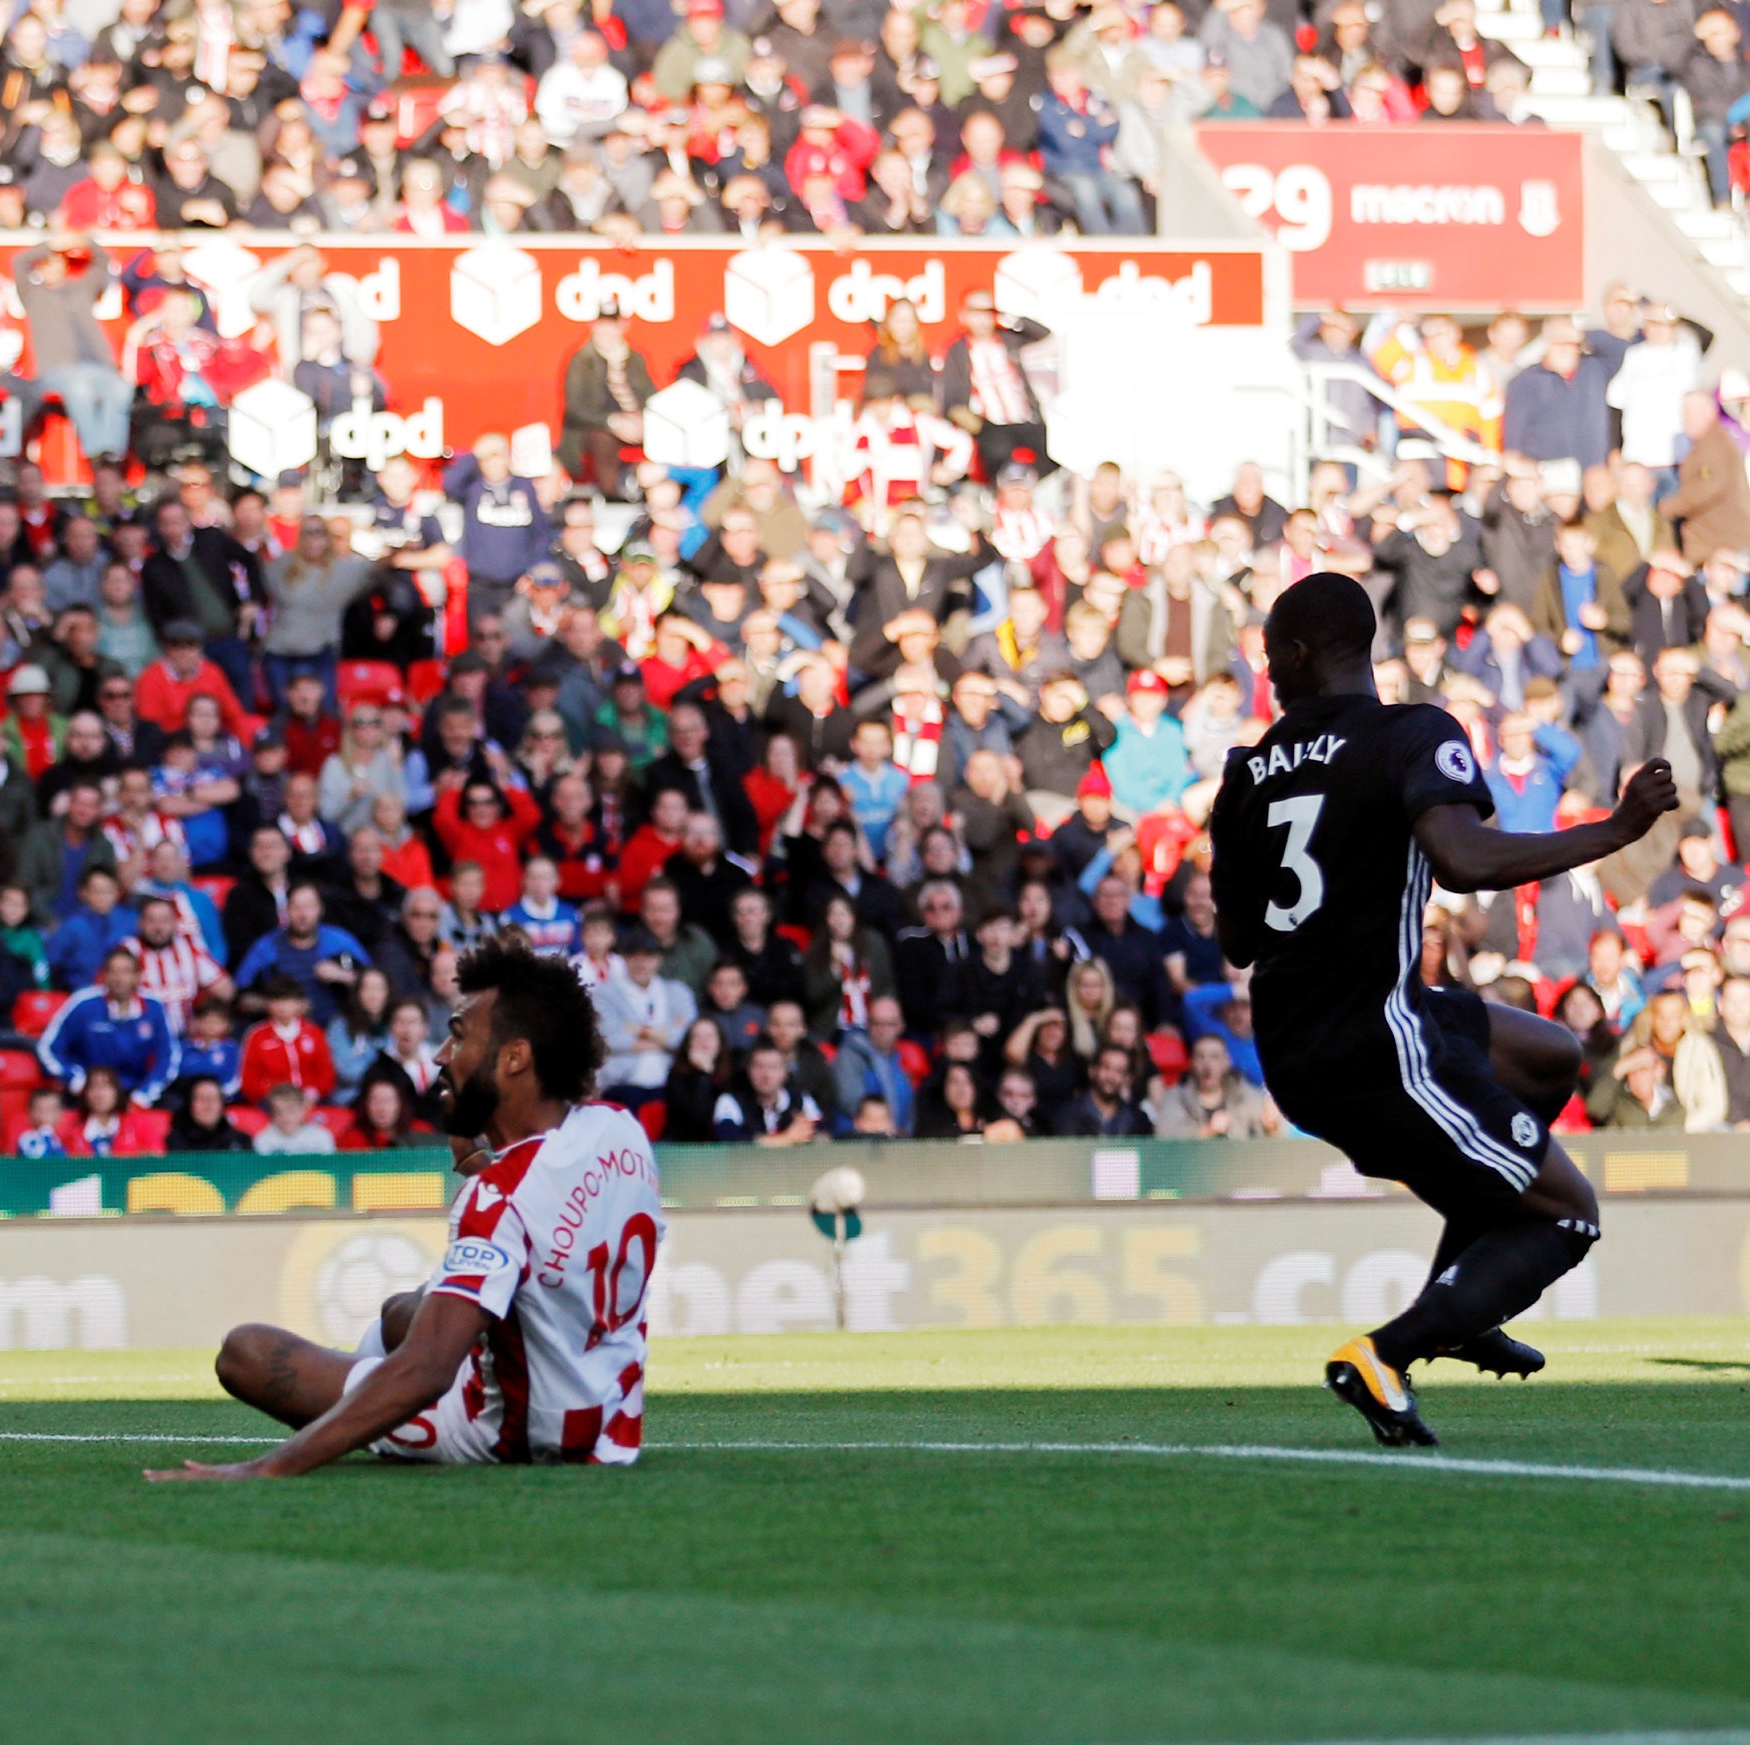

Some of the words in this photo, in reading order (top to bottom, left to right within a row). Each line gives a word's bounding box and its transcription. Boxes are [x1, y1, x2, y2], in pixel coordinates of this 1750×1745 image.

[1350, 183, 1506, 225] macron
[329, 397, 444, 472] dpd
[741, 397, 856, 473] dp
[1263, 793, 1325, 932] 3
[453, 1245, 495, 1261] TOP
[583, 1211, 657, 1353] 10
